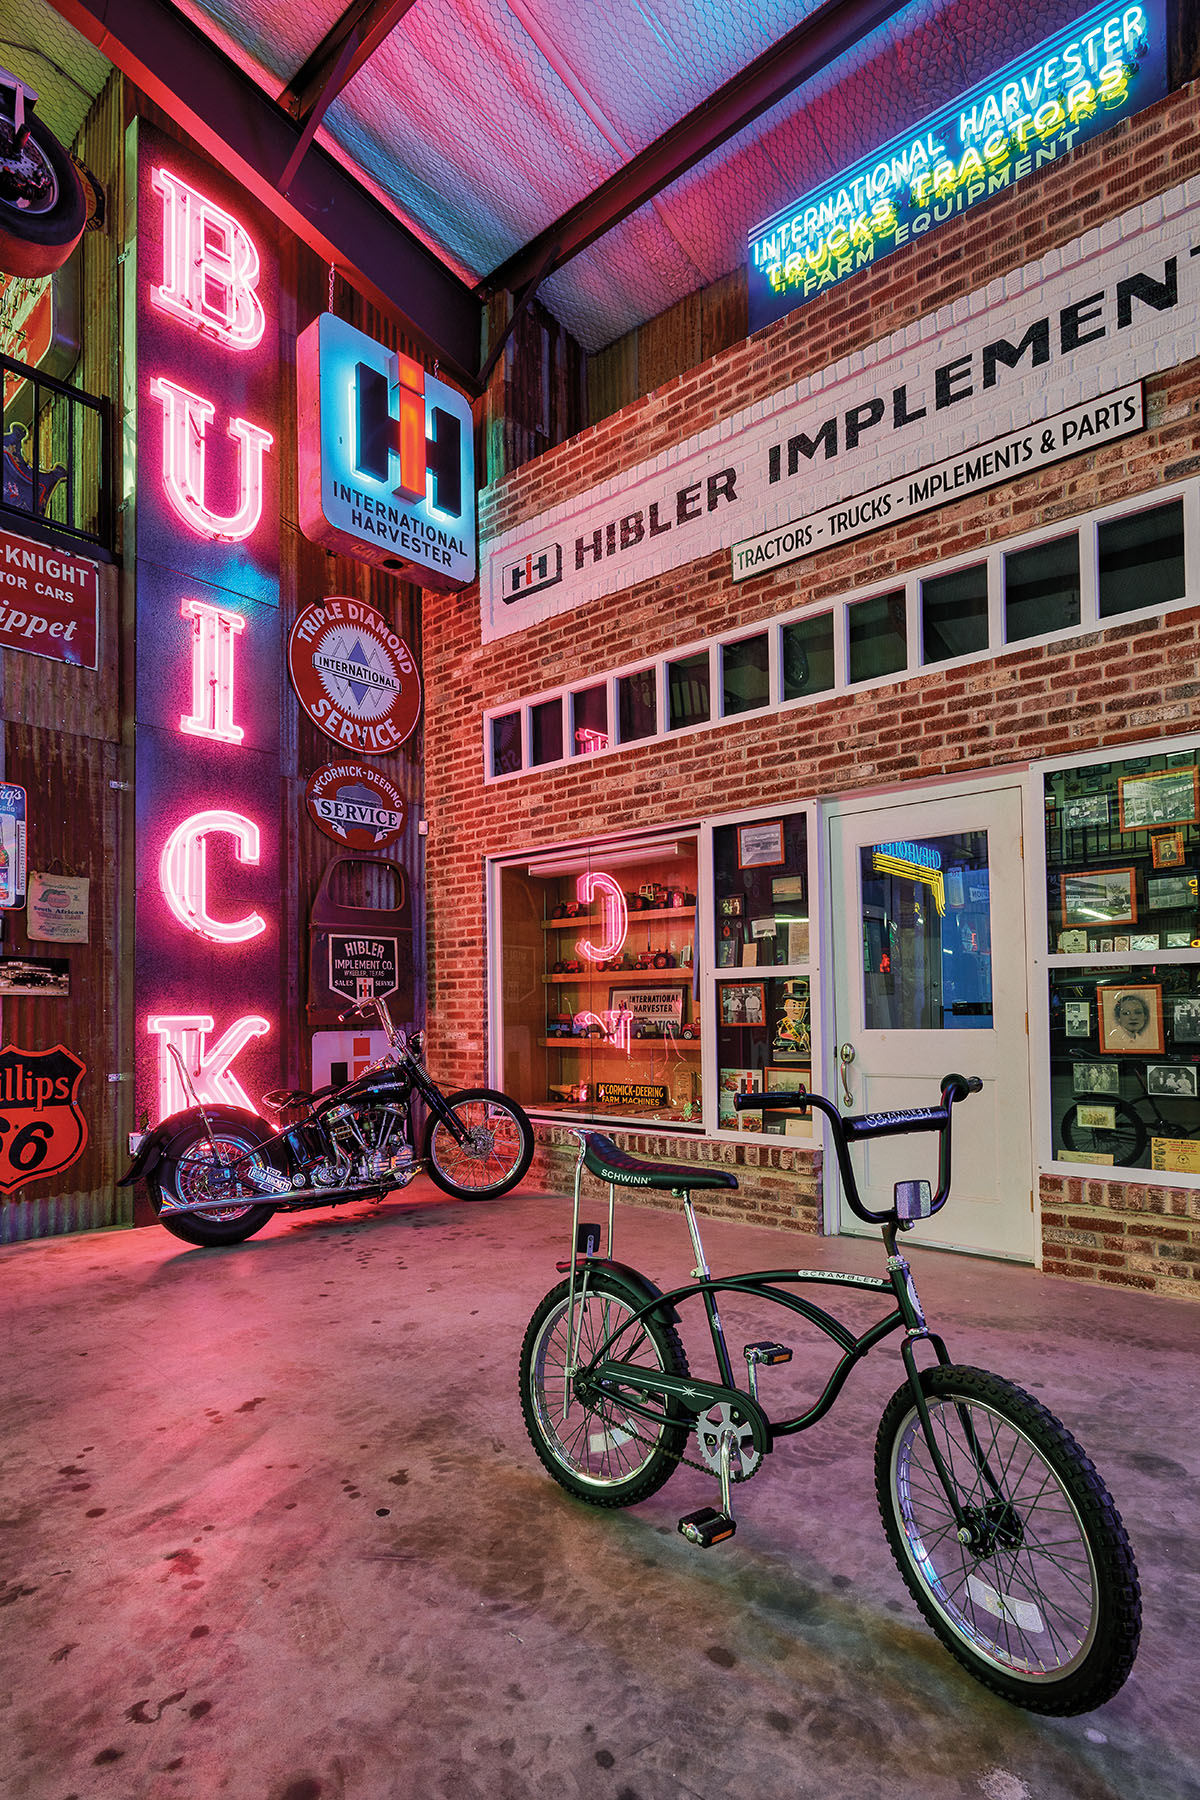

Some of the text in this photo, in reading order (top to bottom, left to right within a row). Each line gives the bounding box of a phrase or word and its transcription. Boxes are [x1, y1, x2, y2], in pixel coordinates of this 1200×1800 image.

[754, 6, 1144, 264] INTERNATIONAL HARVESTER
[766, 60, 1127, 288] TRUCKS TRACTORS
[804, 127, 1080, 297] FARM EQUIPMENT
[736, 529, 812, 571] TRACTORS
[828, 493, 892, 536] TRUCKS
[908, 436, 1033, 506] IMPLEMENTS
[1039, 430, 1055, 455] &
[1062, 395, 1137, 446] PARTS
[333, 480, 468, 557] INTERNATIONAL
[574, 467, 738, 571] HIBLER
[351, 508, 453, 568] HARVESTER
[34, 582, 75, 604] CARS
[146, 166, 274, 1124] BUICK
[297, 602, 412, 674] TRIPLE DIAMOND
[319, 656, 397, 689] INTERNATIONAL
[311, 698, 402, 748] SERVICE
[320, 801, 398, 827] SERVICE
[334, 959, 394, 970] IMPLEMENT CO.
[344, 941, 385, 959] HIBLER
[334, 979, 354, 987] SALES
[629, 994, 678, 1003] INTERNATIONAL
[633, 1004, 673, 1012] HARVESTER
[622, 1097, 660, 1106] MACHINES
[865, 1107, 932, 1127] SCRAMBLER
[601, 1168, 650, 1185] SCHWINN
[802, 1270, 880, 1284] SCRAMBLER
